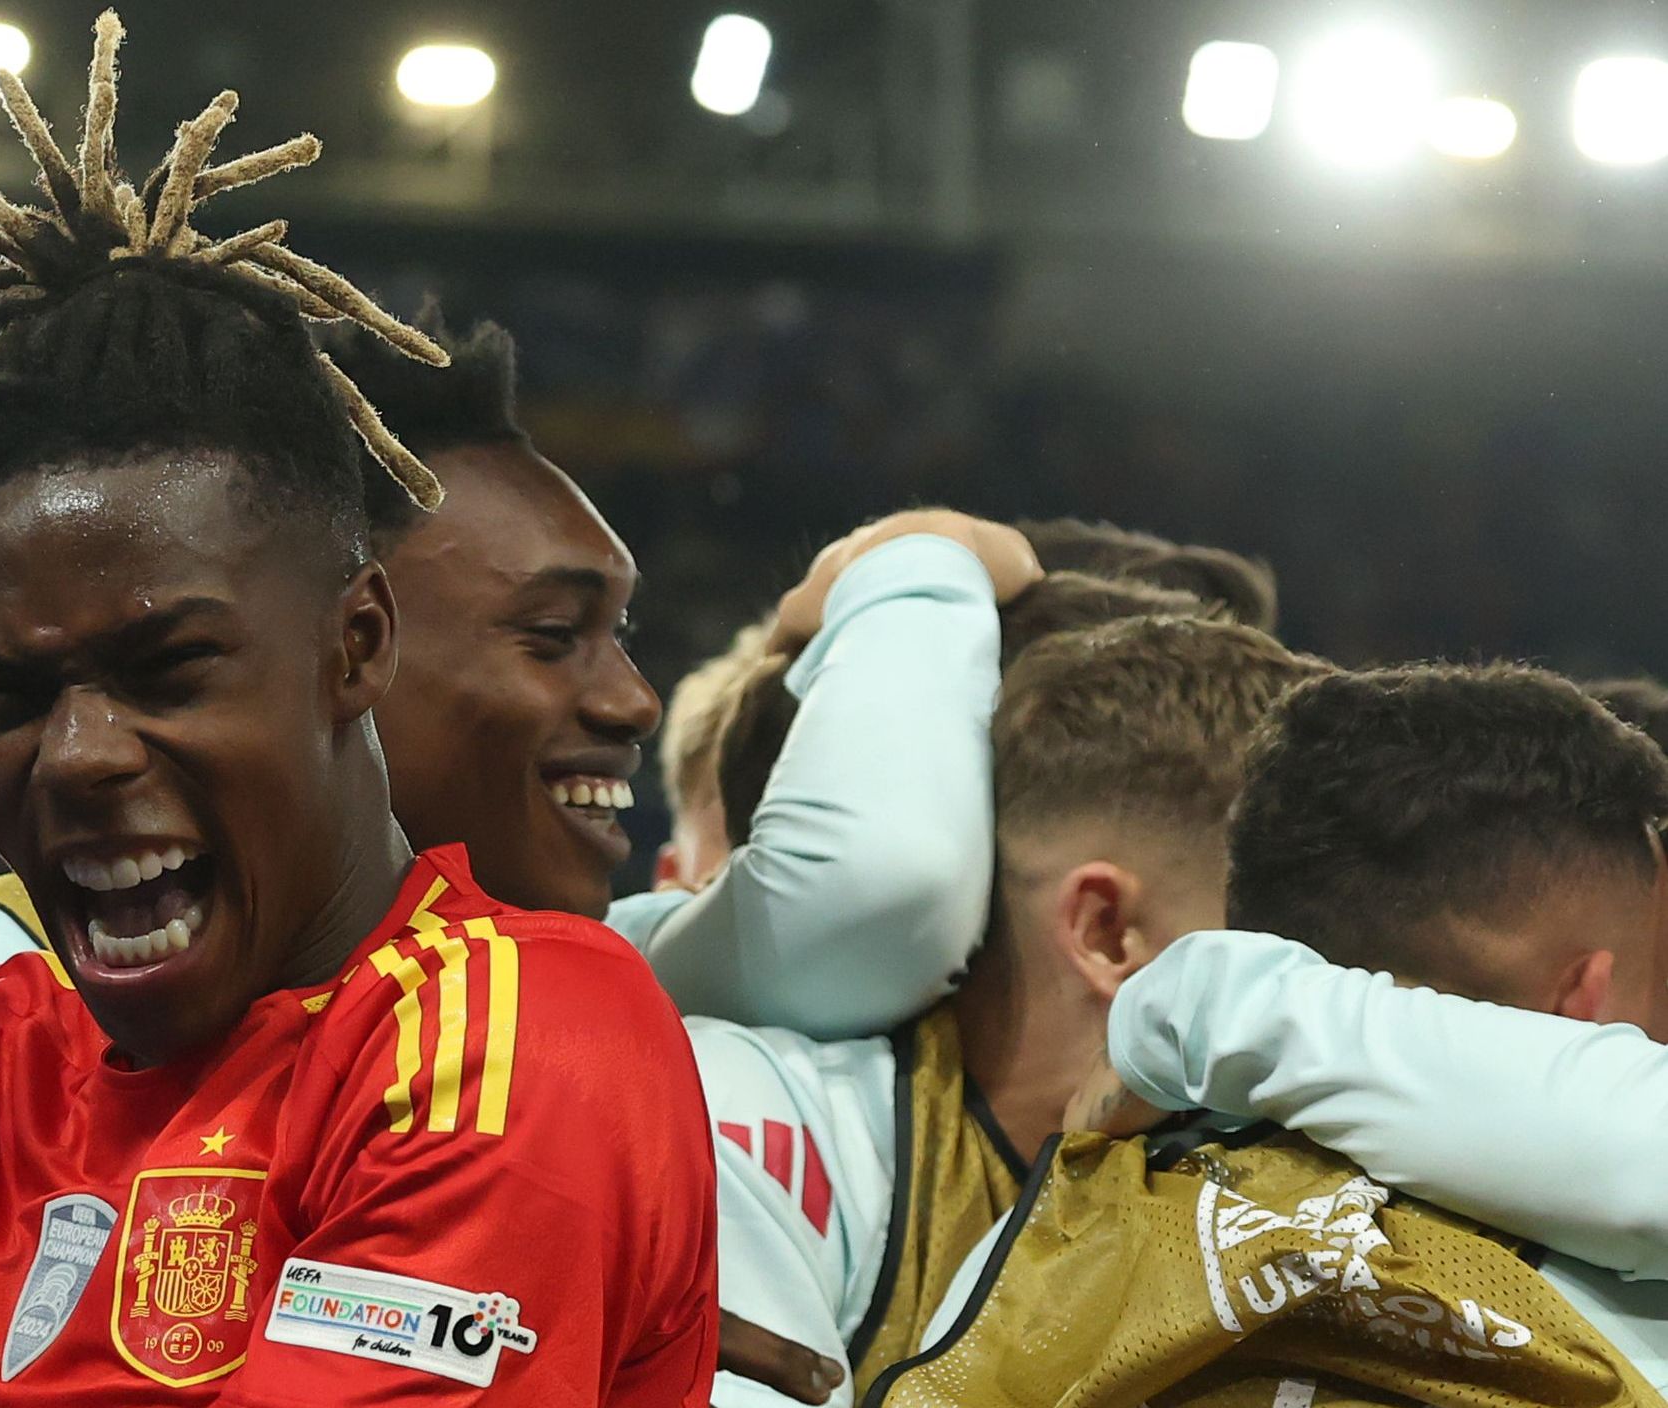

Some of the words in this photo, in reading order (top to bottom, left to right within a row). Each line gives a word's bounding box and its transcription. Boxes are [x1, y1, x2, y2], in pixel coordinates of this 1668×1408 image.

[48, 1218, 111, 1250] EUROPEAN
[287, 1266, 322, 1283] UEFA
[278, 1290, 421, 1334] FOUNDATION
[15, 1315, 54, 1339] 2024
[427, 1304, 494, 1357] 10
[496, 1327, 530, 1346] YEARS
[145, 1336, 158, 1350] 19
[206, 1339, 225, 1354] 09
[352, 1334, 369, 1351] for
[369, 1337, 412, 1359] children
